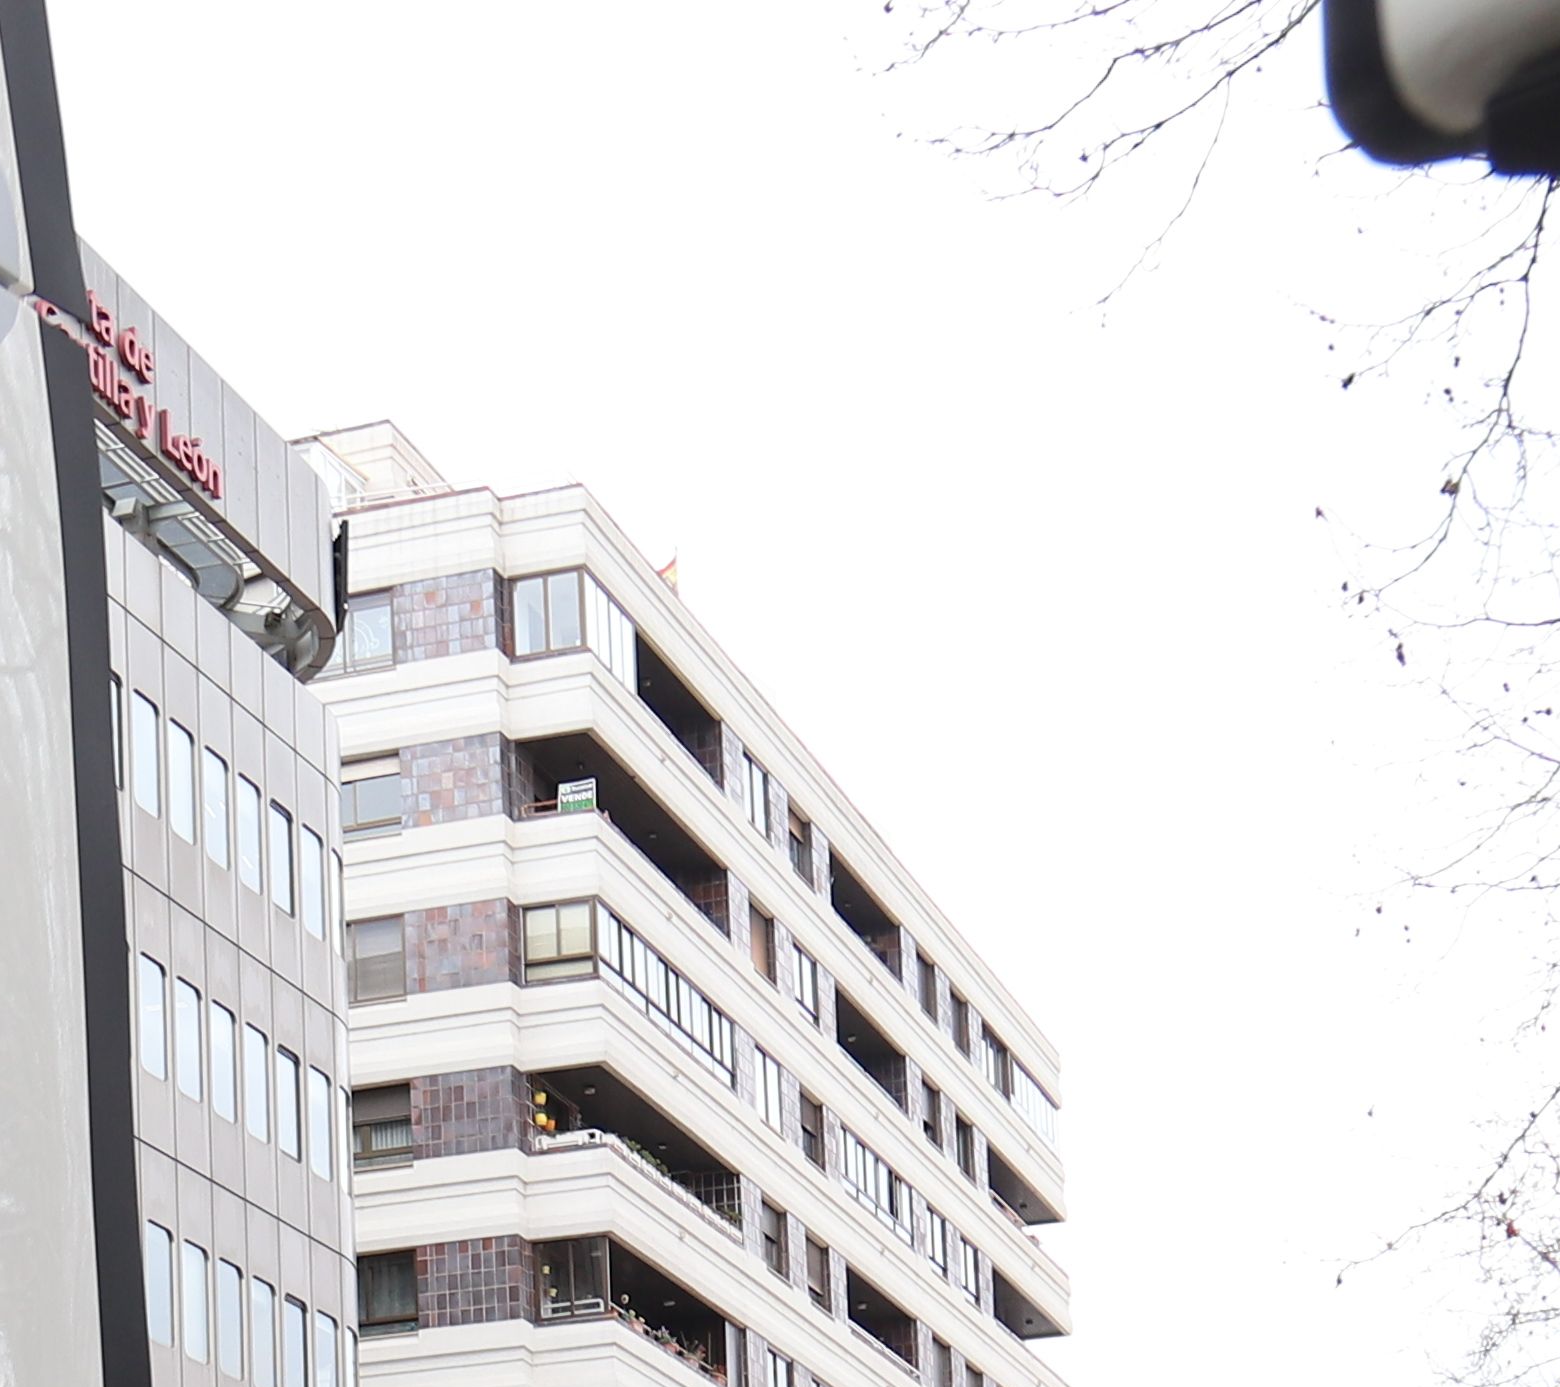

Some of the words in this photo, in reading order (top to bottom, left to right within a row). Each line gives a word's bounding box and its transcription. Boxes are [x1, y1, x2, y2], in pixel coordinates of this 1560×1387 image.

[119, 327, 154, 384] de
[136, 396, 155, 440] y
[159, 409, 222, 499] León
[561, 790, 593, 803] VENDE
